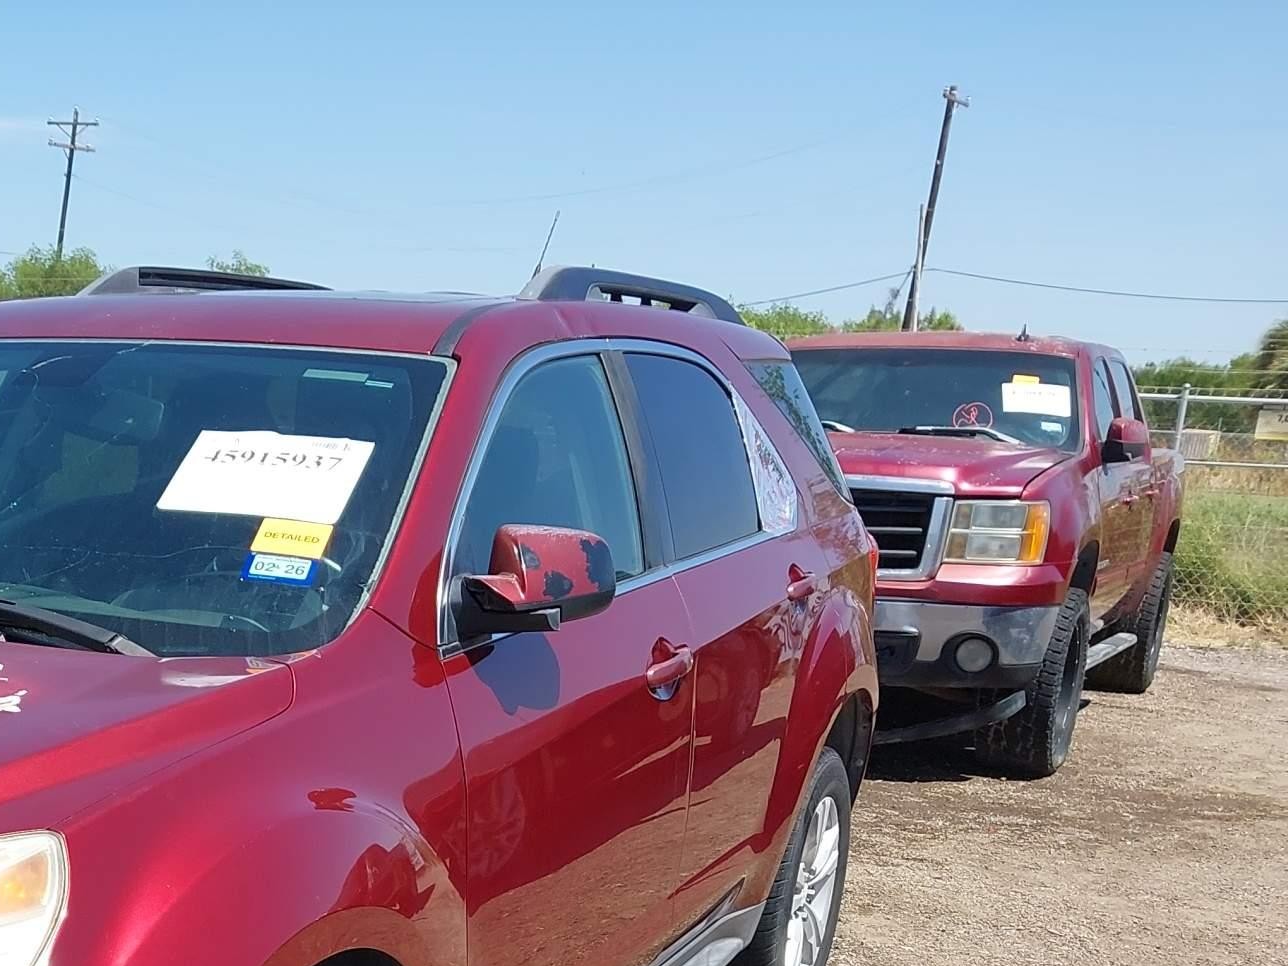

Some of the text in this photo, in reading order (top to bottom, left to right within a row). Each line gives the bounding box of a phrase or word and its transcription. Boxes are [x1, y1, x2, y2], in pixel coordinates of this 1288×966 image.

[204, 449, 344, 471] 45915937
[263, 531, 320, 544] DETAILED
[254, 560, 276, 573] 02
[284, 564, 306, 576] 26
